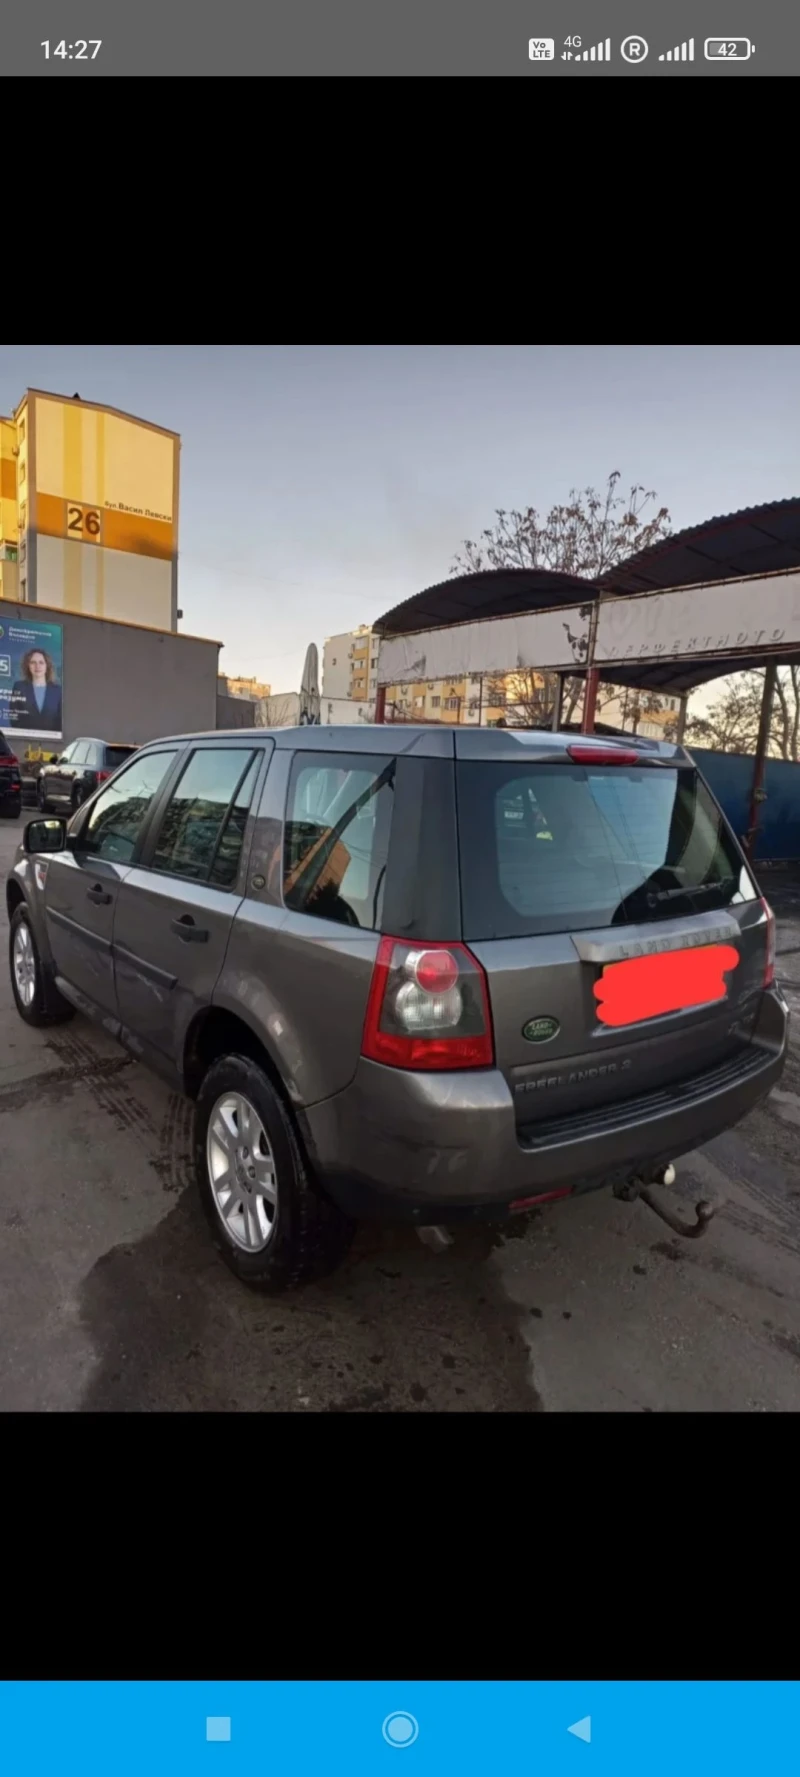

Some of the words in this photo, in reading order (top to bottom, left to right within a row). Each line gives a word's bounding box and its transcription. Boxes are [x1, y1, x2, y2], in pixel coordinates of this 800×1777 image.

[67, 507, 100, 535] 26
[118, 502, 143, 514] Васил
[144, 509, 172, 521] Левски
[618, 937, 671, 958] LAND
[680, 927, 732, 949] ROVER
[514, 1064, 617, 1094] FREELANDER
[620, 1058, 633, 1071] 2
